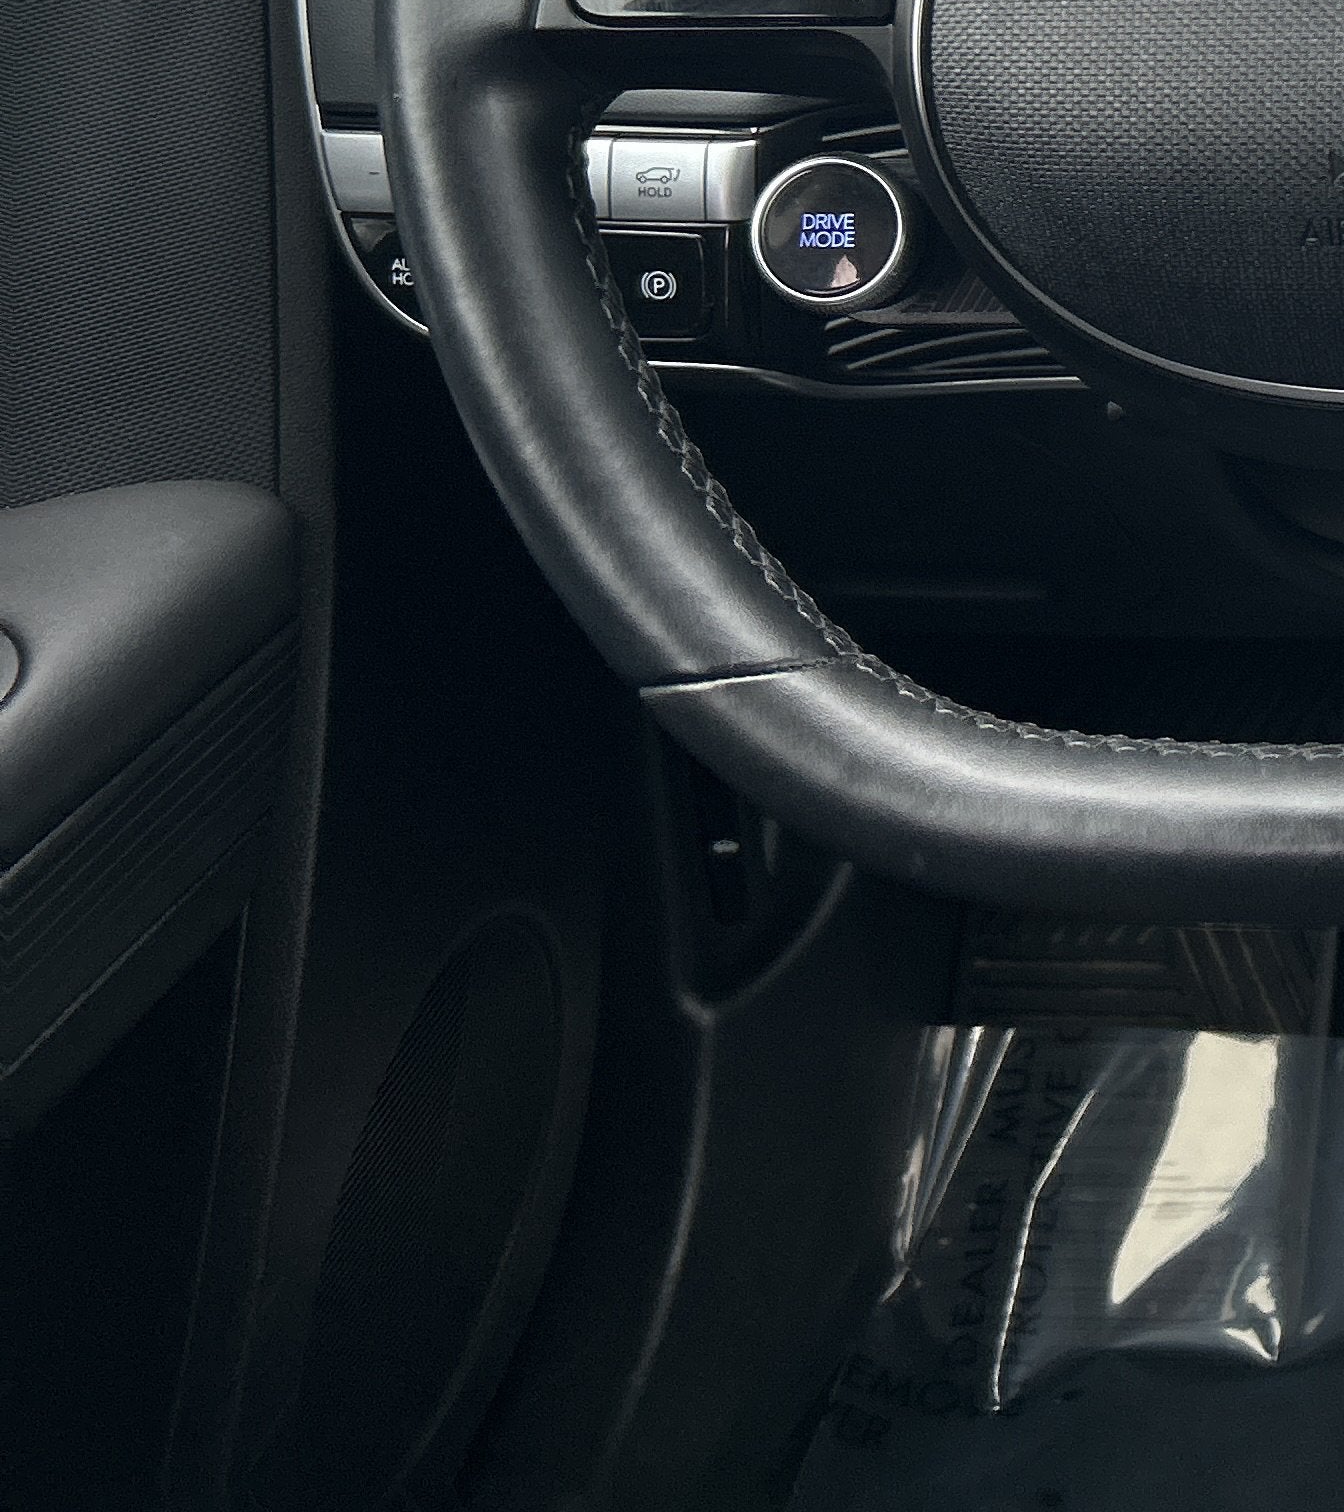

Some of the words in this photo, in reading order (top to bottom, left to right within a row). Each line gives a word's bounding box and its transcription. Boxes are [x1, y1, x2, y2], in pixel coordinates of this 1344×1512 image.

[637, 186, 673, 199] HOLD
[802, 212, 856, 231] DRIVE
[800, 231, 856, 248] MODE
